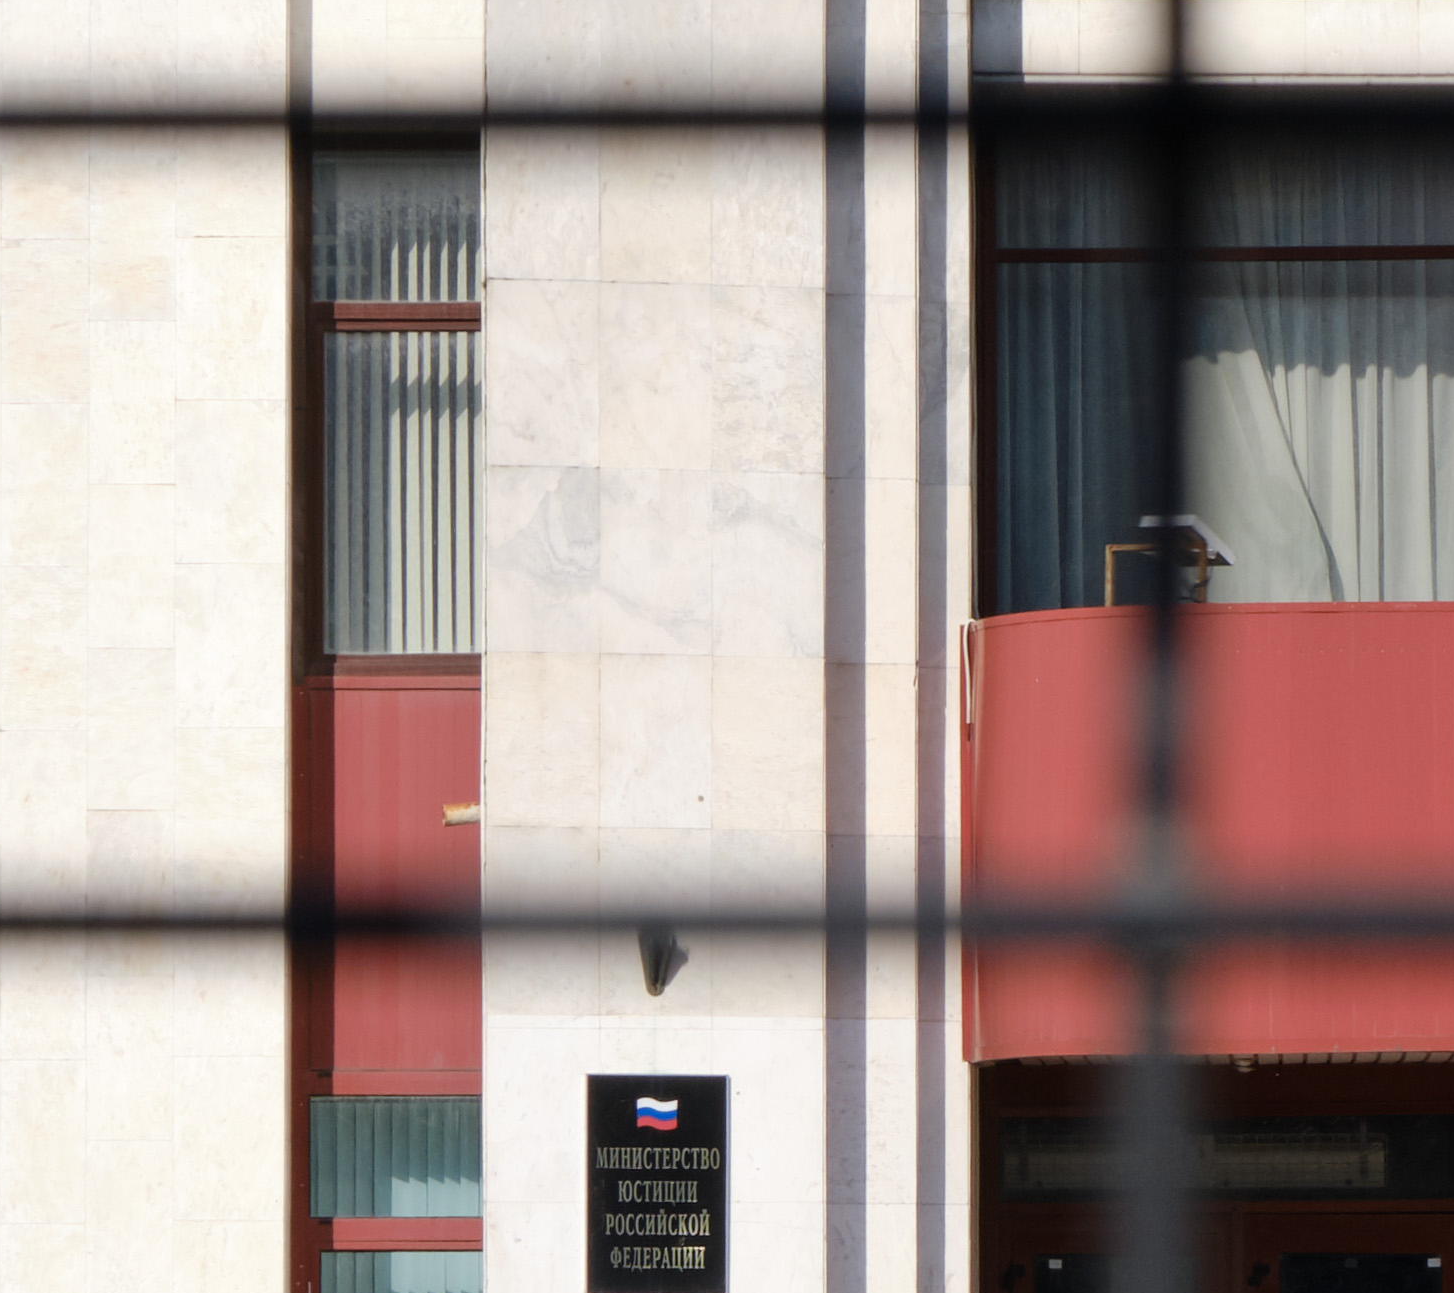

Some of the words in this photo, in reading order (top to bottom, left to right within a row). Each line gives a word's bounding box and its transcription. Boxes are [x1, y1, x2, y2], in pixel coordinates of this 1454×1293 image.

[596, 1147, 721, 1170] МИНИСТЕРСТВО
[618, 1180, 698, 1206] ЮСТИЦИИ
[605, 1209, 710, 1236] РОССИЙСКОЙ
[610, 1246, 706, 1273] ФЕДЕРАЦИИ
